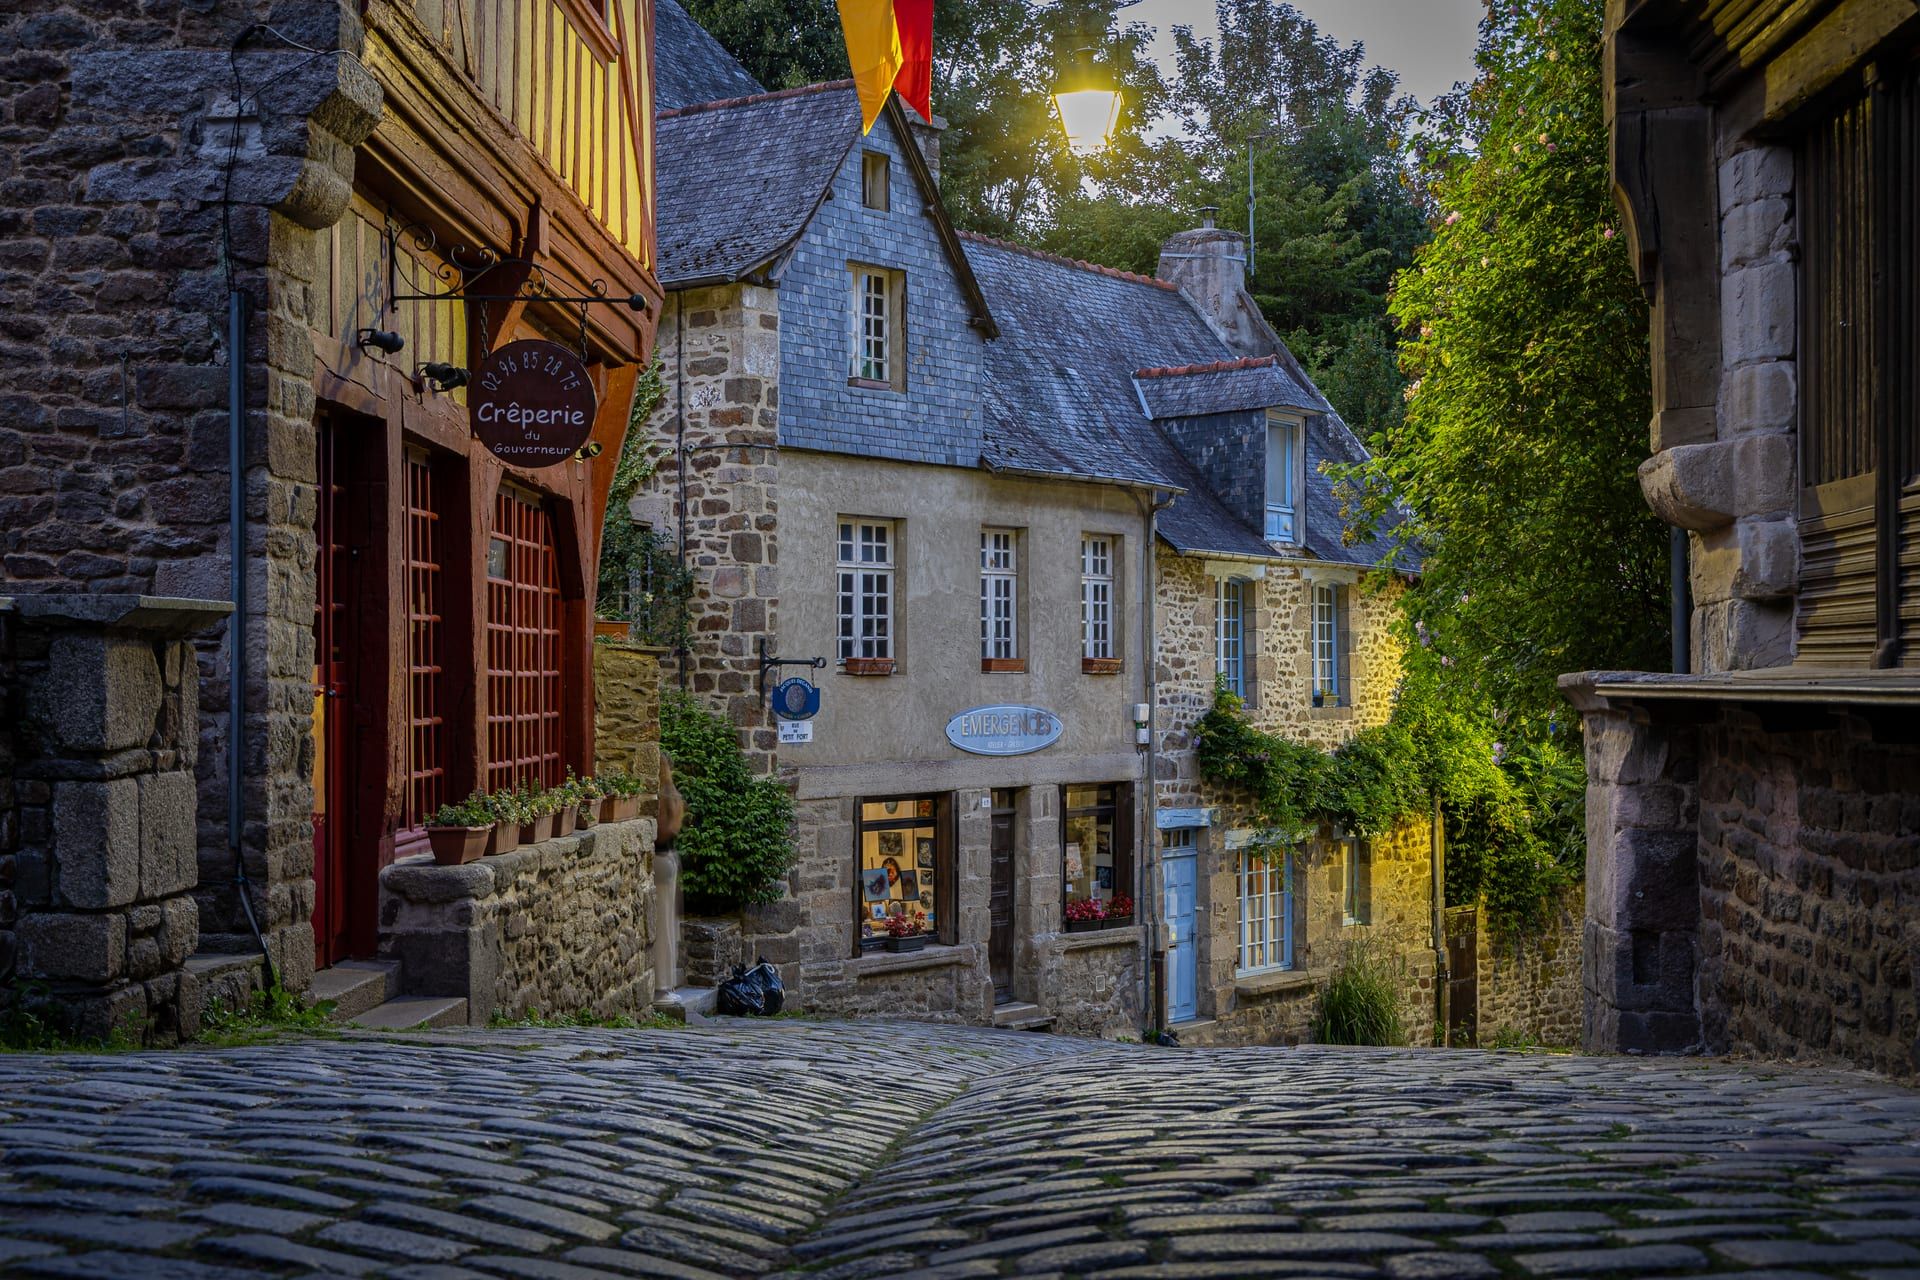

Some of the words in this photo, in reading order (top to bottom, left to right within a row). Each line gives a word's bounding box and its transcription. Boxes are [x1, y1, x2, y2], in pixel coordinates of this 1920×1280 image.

[482, 372, 502, 392] 02
[499, 355, 518, 377] 96
[522, 351, 540, 369] 85
[544, 355, 562, 376] 28
[559, 371, 581, 391] 75
[477, 401, 585, 430] Crêperie
[524, 430, 540, 441] du
[494, 442, 571, 455] Gouverneur
